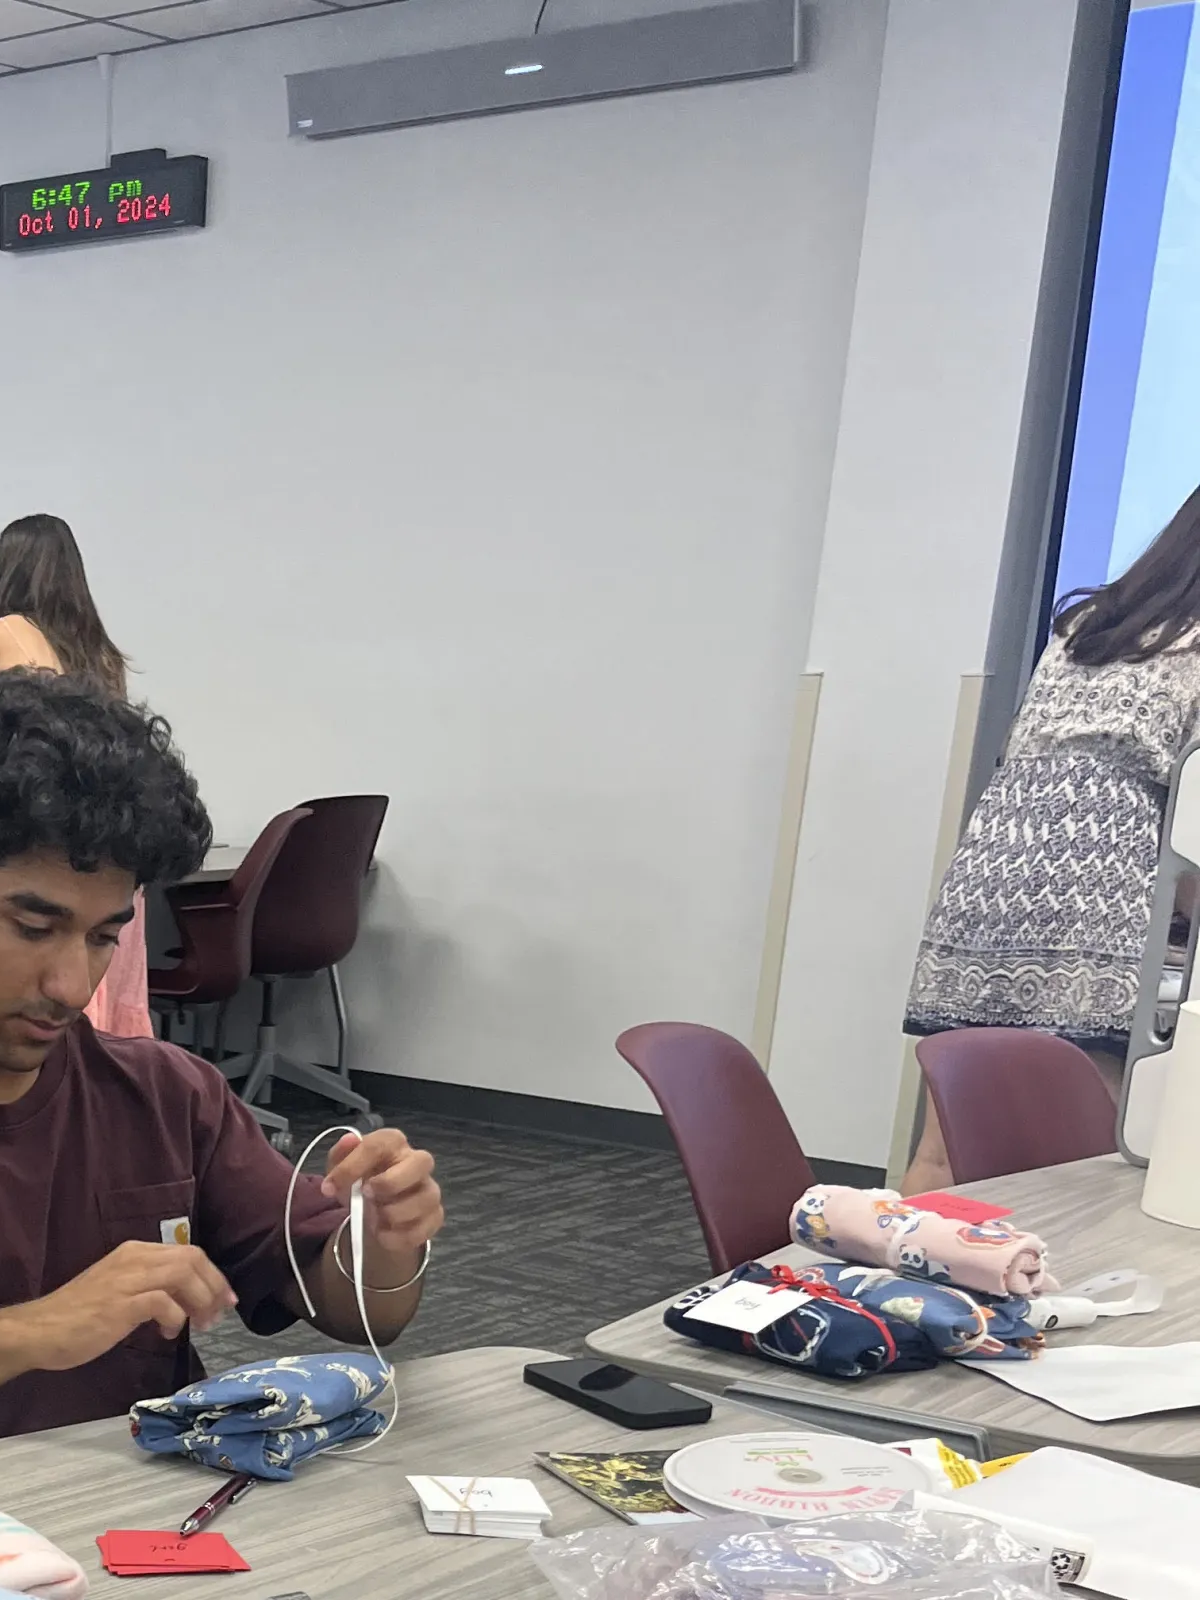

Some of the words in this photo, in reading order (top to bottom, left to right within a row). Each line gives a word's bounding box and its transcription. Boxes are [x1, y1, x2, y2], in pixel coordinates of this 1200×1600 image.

[18, 210, 54, 236] Oct
[67, 204, 103, 230] 01,
[116, 192, 171, 224] 2024
[31, 181, 91, 211] 6:47
[108, 179, 142, 203] pm
